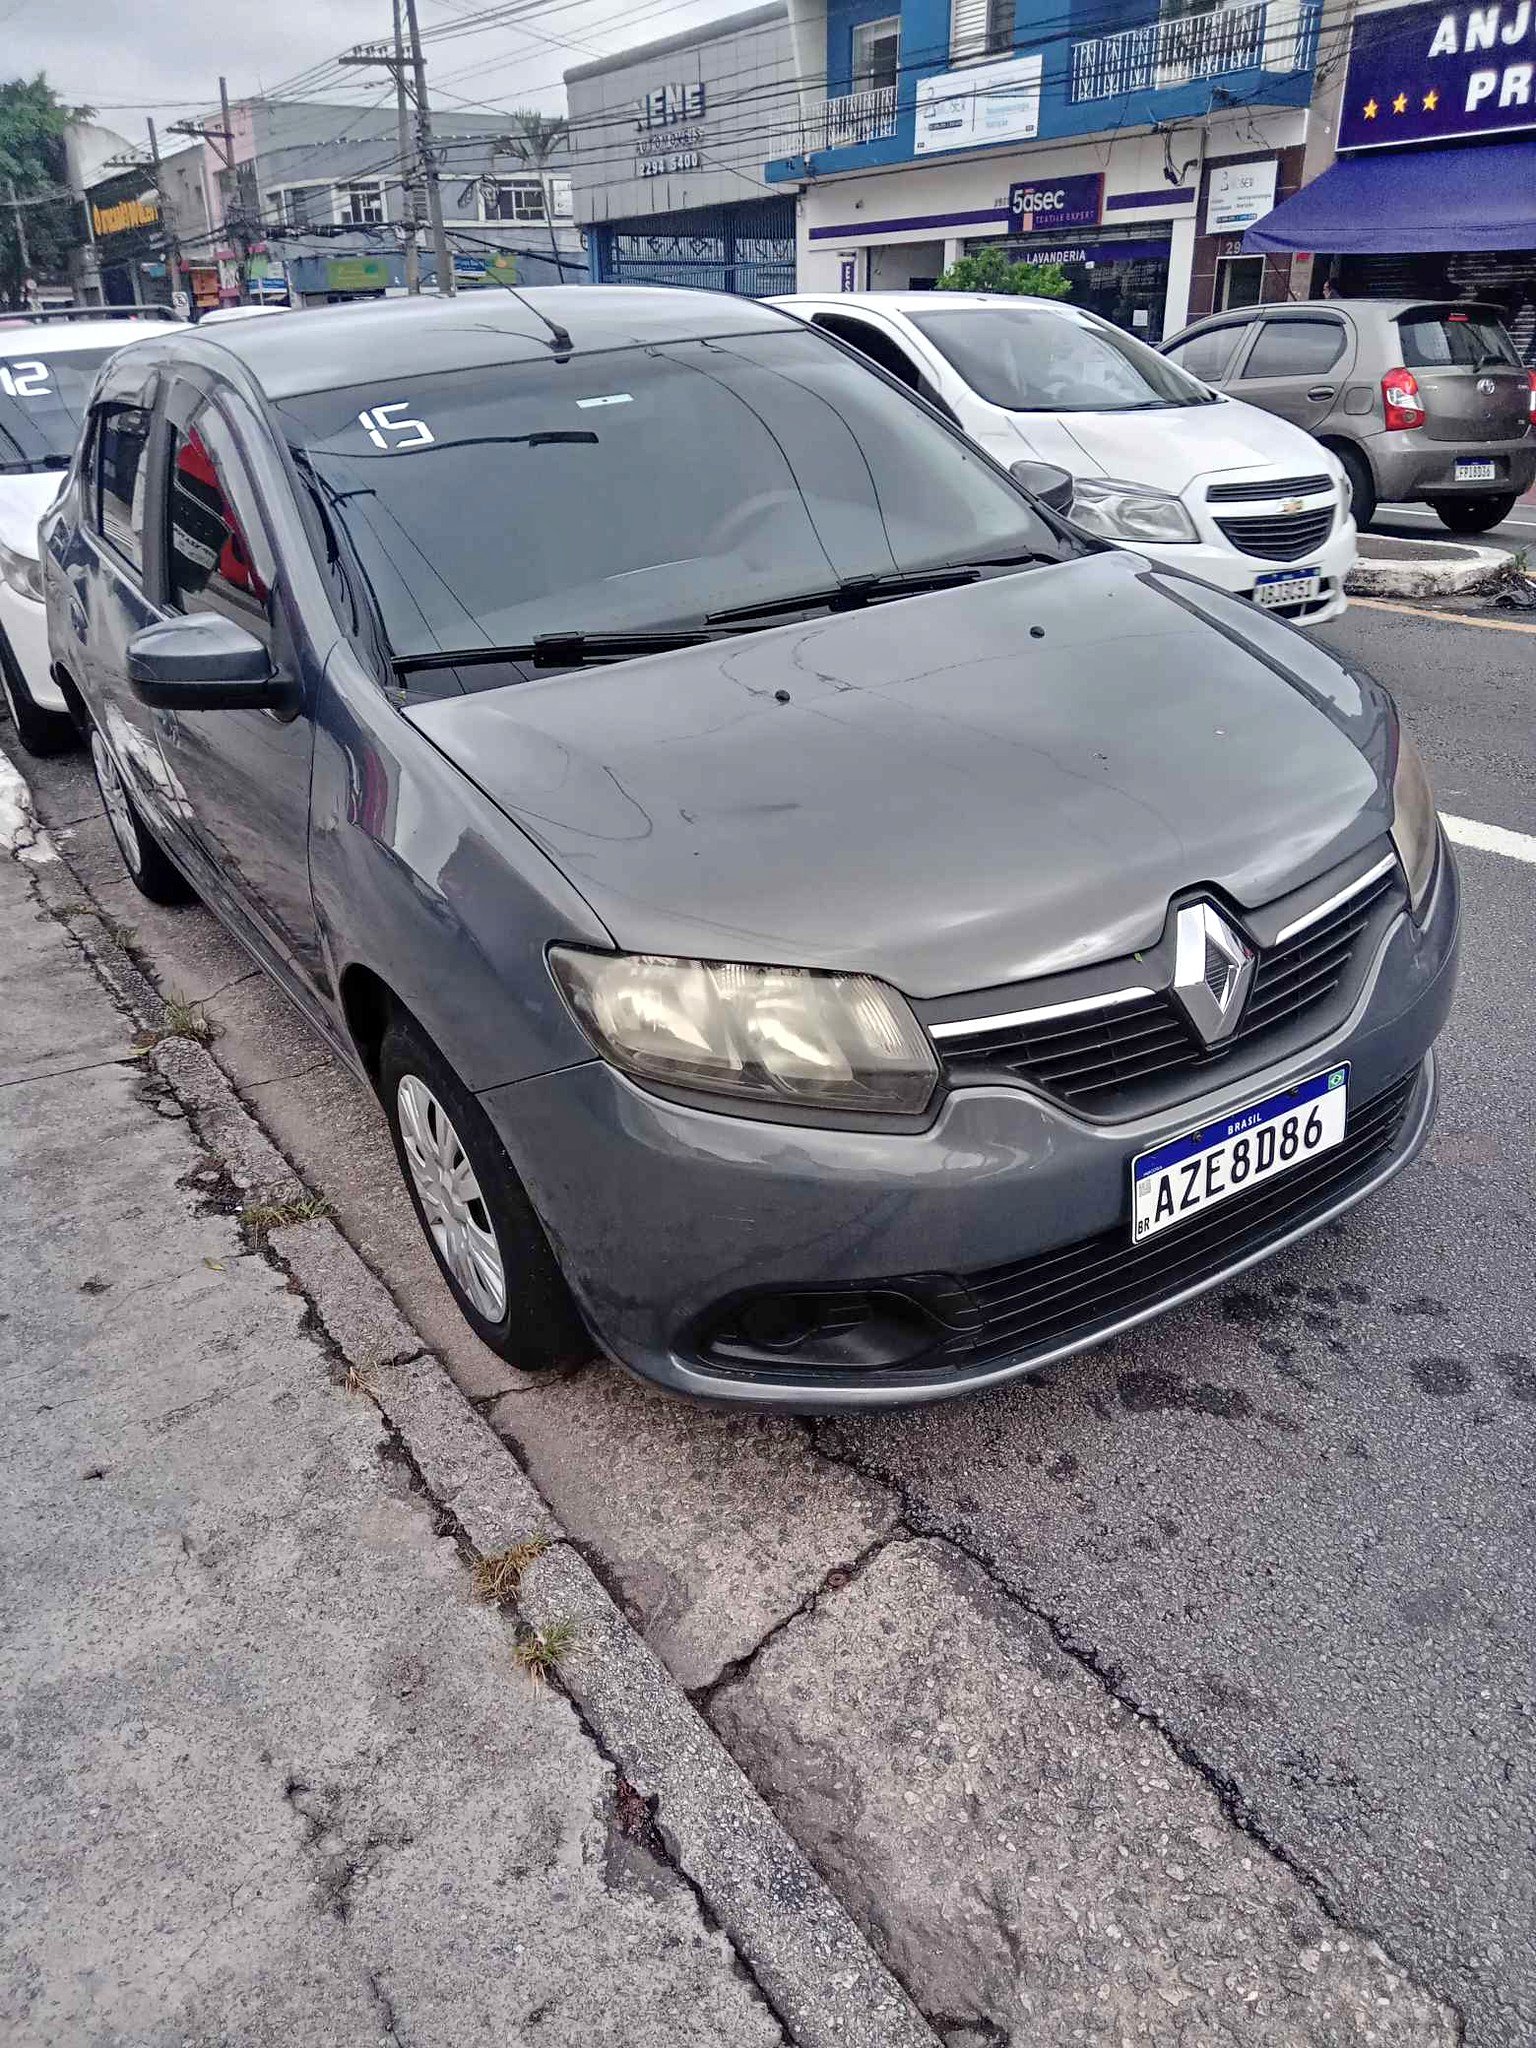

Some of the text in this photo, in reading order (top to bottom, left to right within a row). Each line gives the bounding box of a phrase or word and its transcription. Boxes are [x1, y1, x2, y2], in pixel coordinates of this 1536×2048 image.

[1427, 0, 1536, 57] ANJ
[1465, 62, 1536, 112] PR
[1026, 249, 1087, 265] LAVANDERIA
[0, 361, 52, 397] 12
[358, 402, 435, 449] 15
[1227, 1112, 1263, 1135] BRASIL
[1154, 1104, 1323, 1223] AZE8D86
[1137, 1217, 1150, 1234] BR
